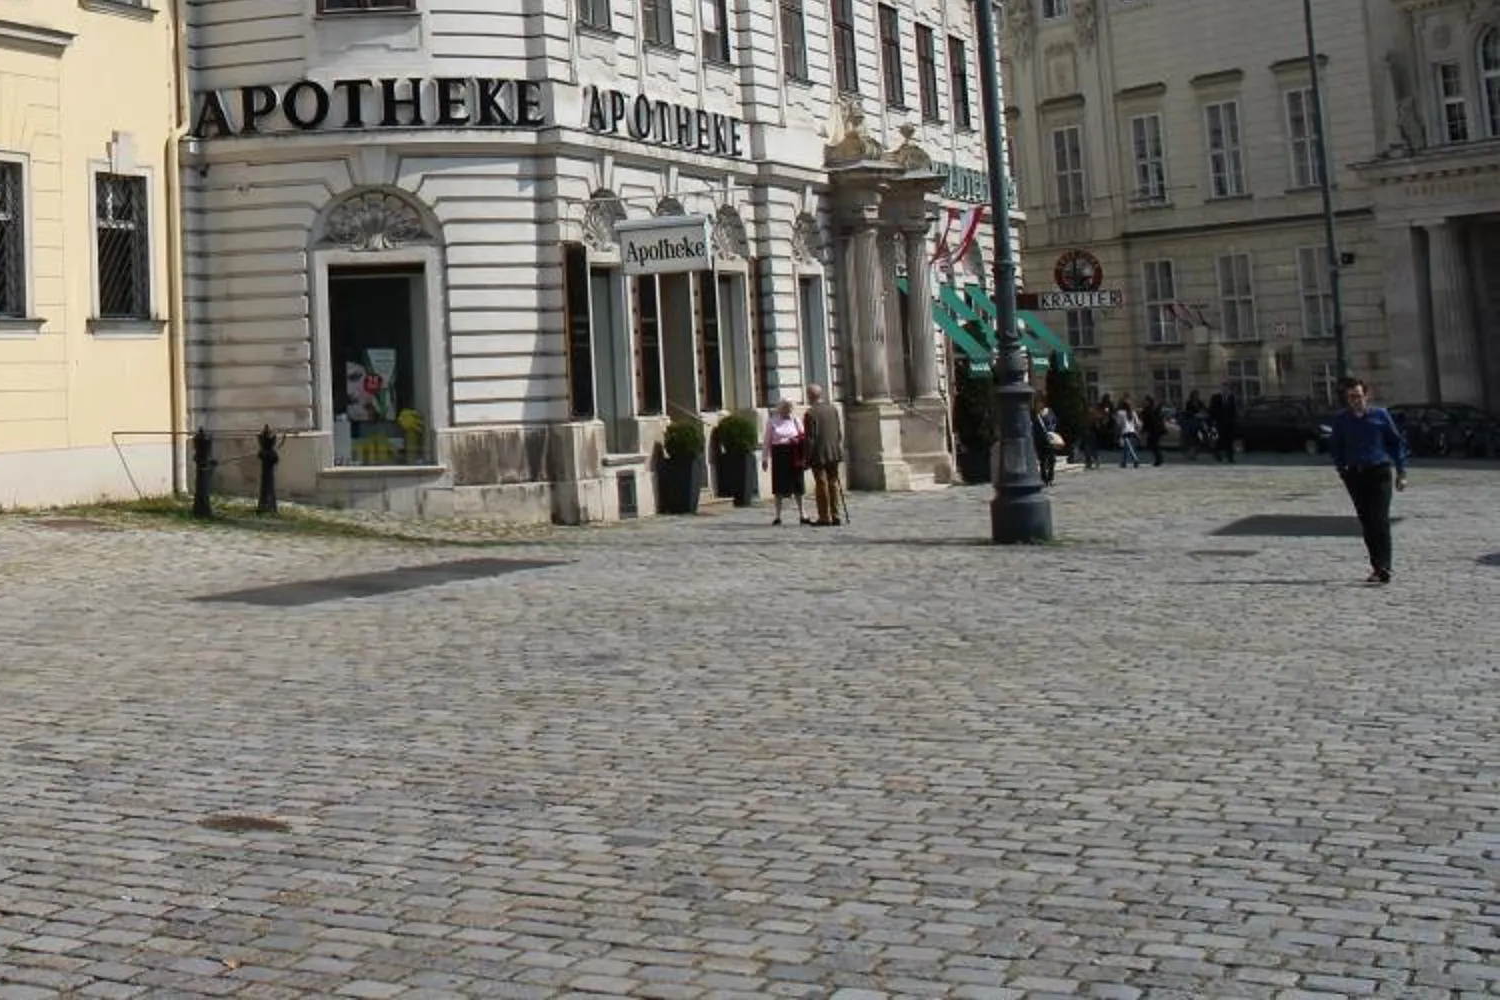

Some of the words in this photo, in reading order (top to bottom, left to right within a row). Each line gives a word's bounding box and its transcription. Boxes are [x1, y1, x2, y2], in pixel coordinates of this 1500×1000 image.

[195, 77, 546, 138] APOTHEKE
[584, 84, 743, 157] APOTHEKE
[626, 236, 705, 266] Apotheke
